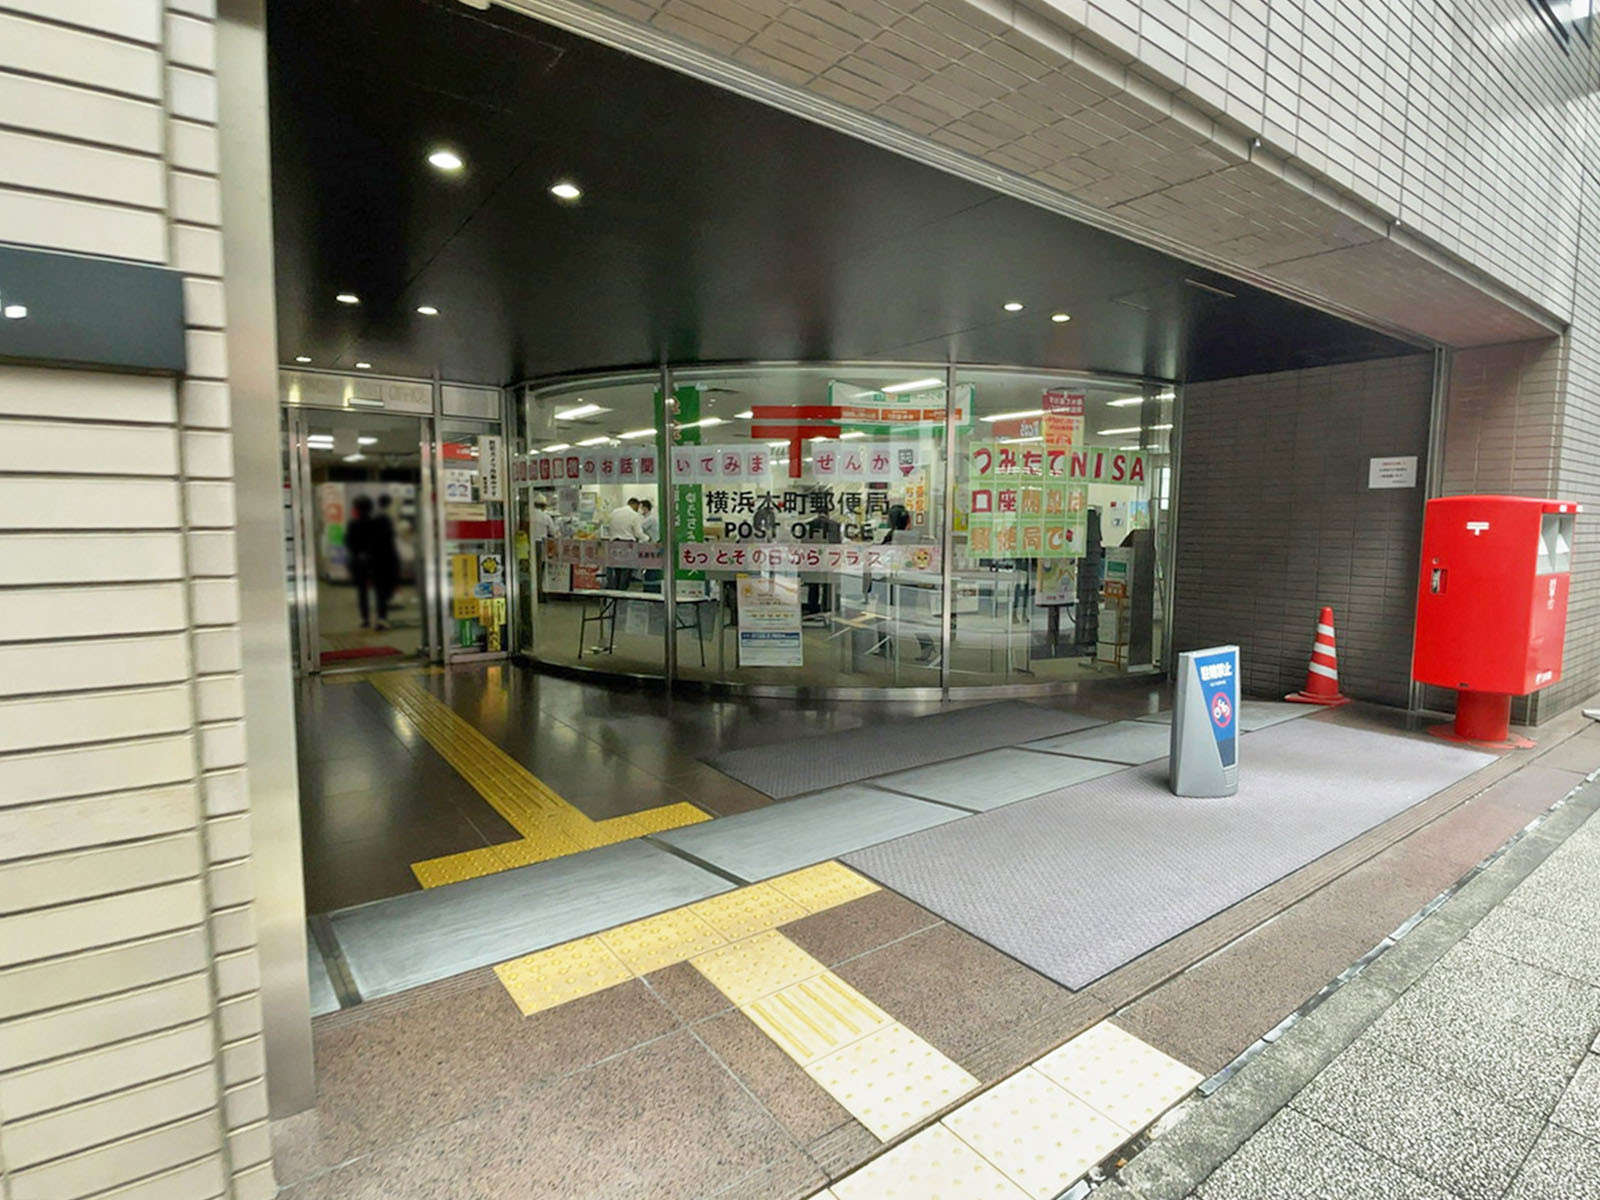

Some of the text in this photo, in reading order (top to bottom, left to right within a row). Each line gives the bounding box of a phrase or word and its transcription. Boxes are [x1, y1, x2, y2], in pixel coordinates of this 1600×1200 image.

[973, 447, 1144, 481] つみたてNISA
[706, 490, 889, 516] 横浜本町郵便局
[724, 521, 874, 541] POST OFFCE
